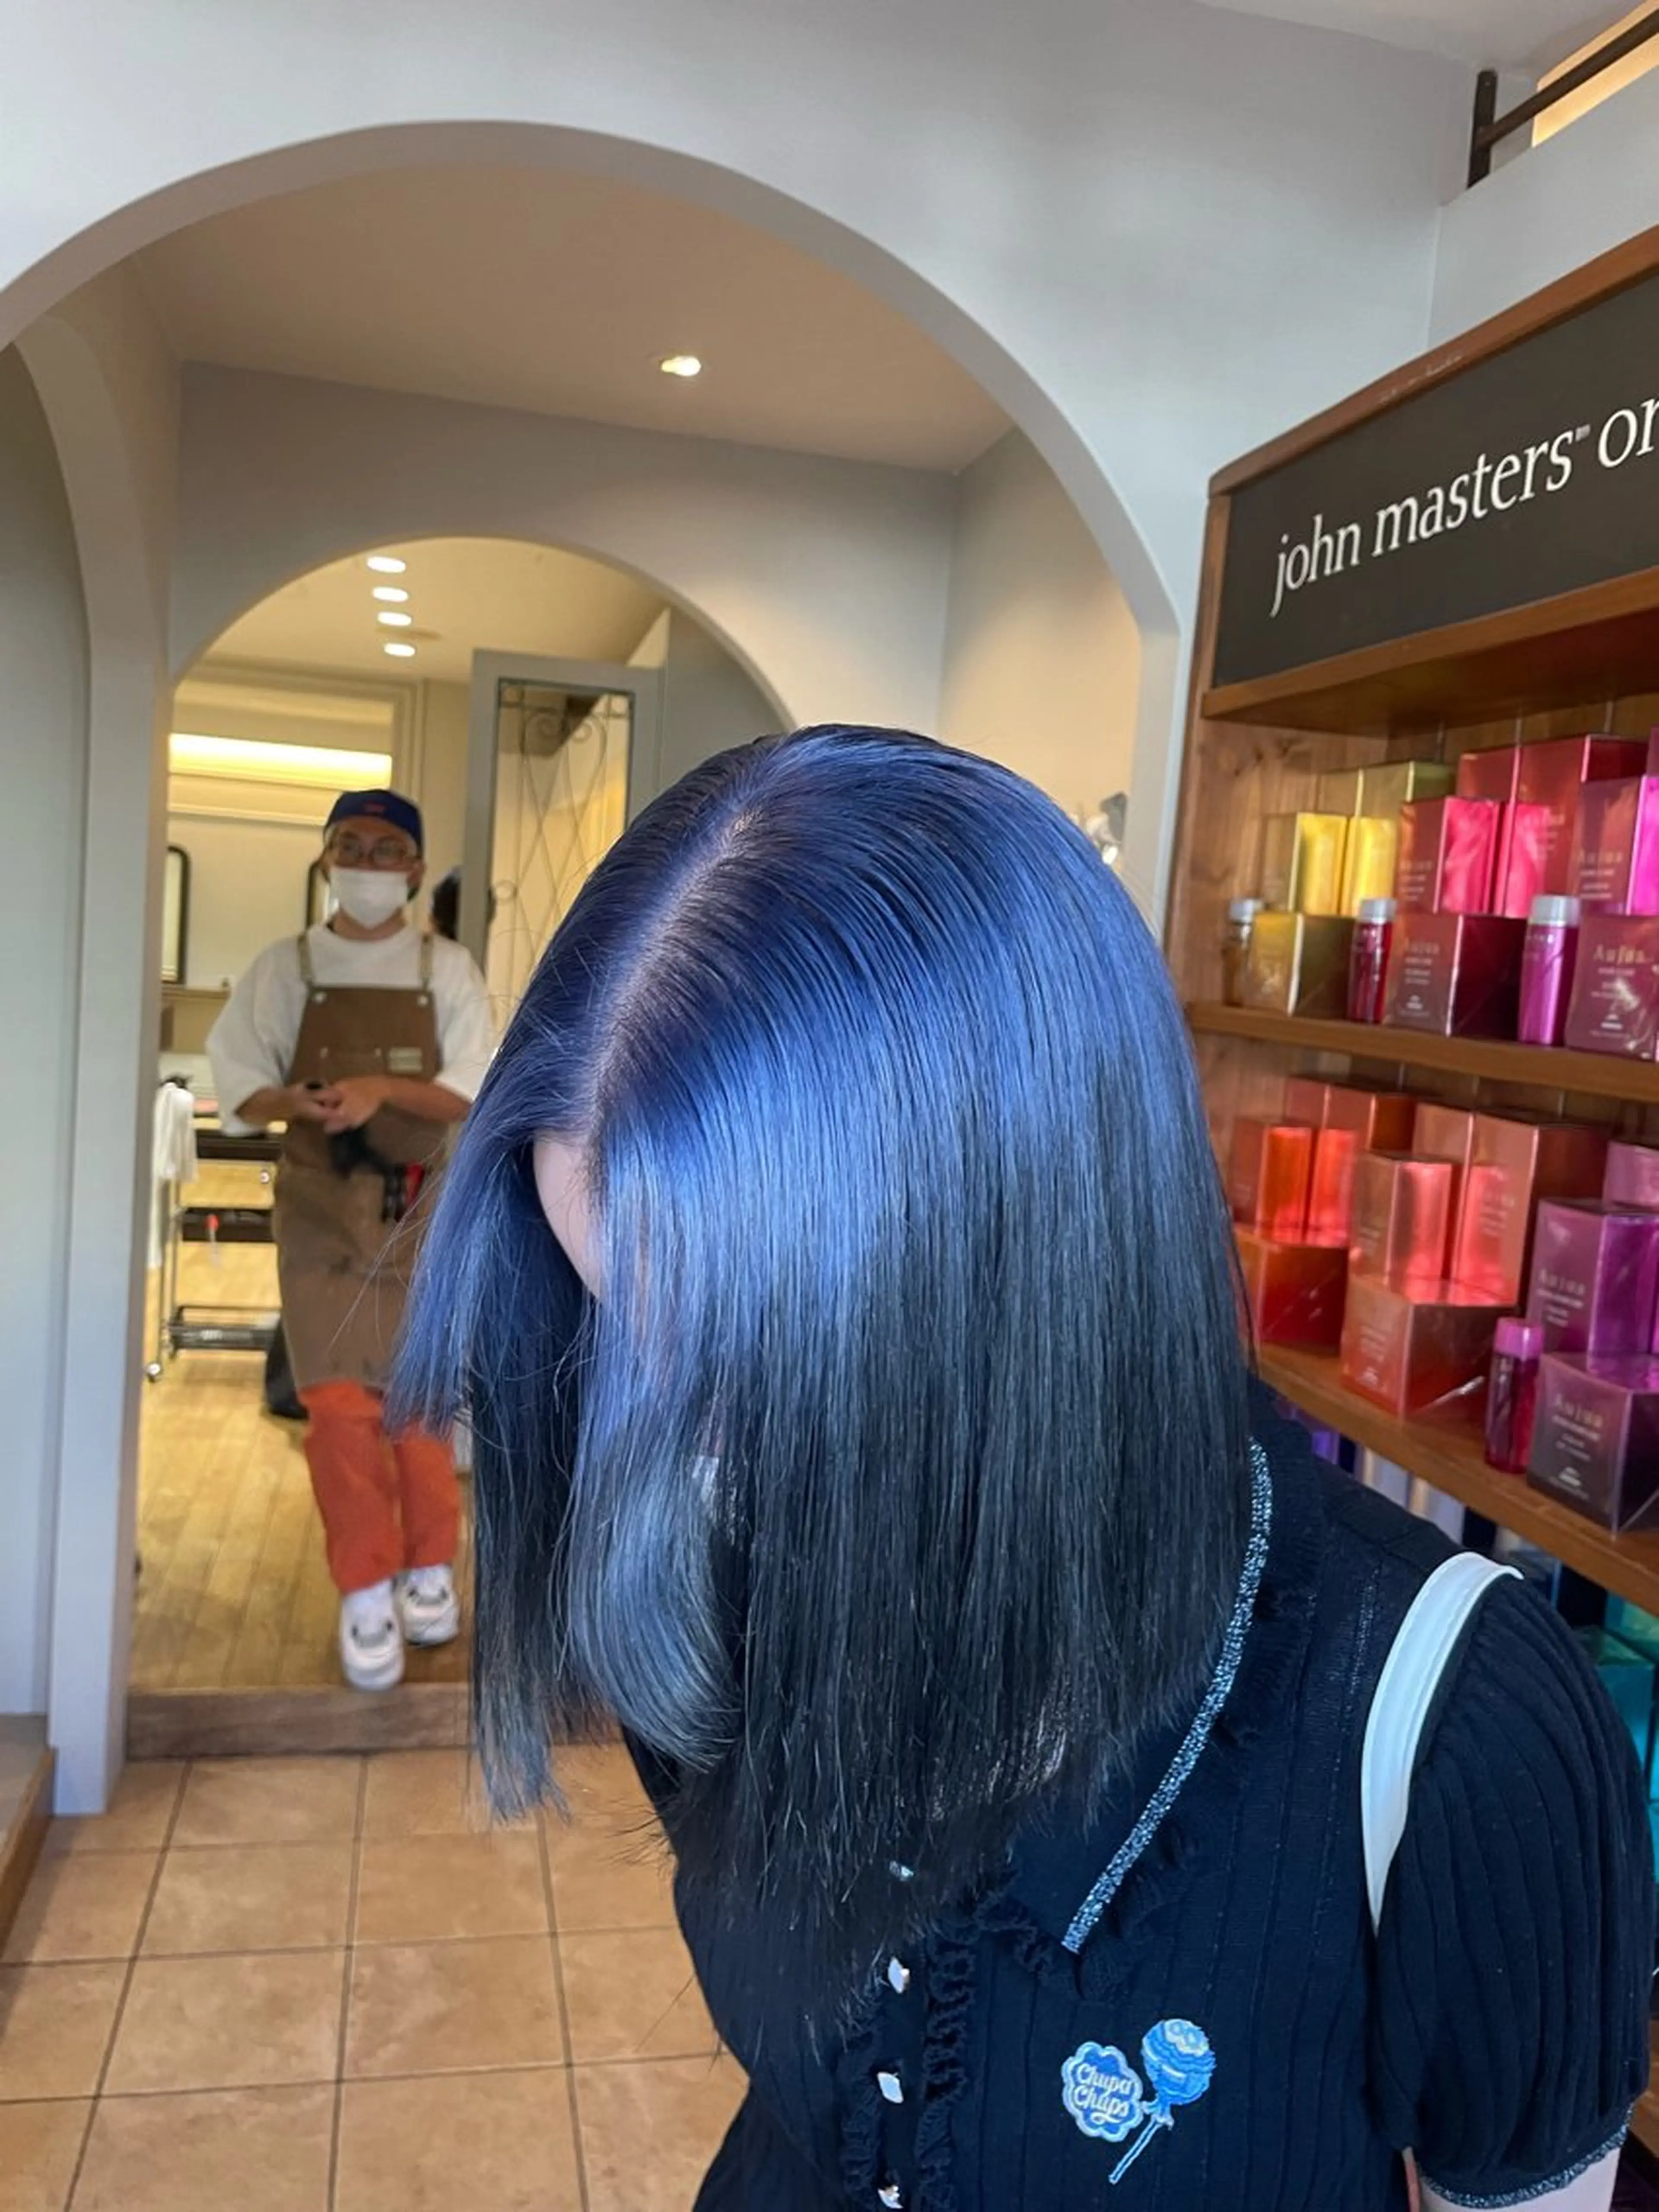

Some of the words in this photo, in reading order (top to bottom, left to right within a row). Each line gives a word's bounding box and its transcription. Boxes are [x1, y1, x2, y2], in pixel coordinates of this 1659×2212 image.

[1271, 515, 1360, 618] john
[1077, 2063, 1131, 2097] Chupa
[1074, 2085, 1128, 2117] Chups
